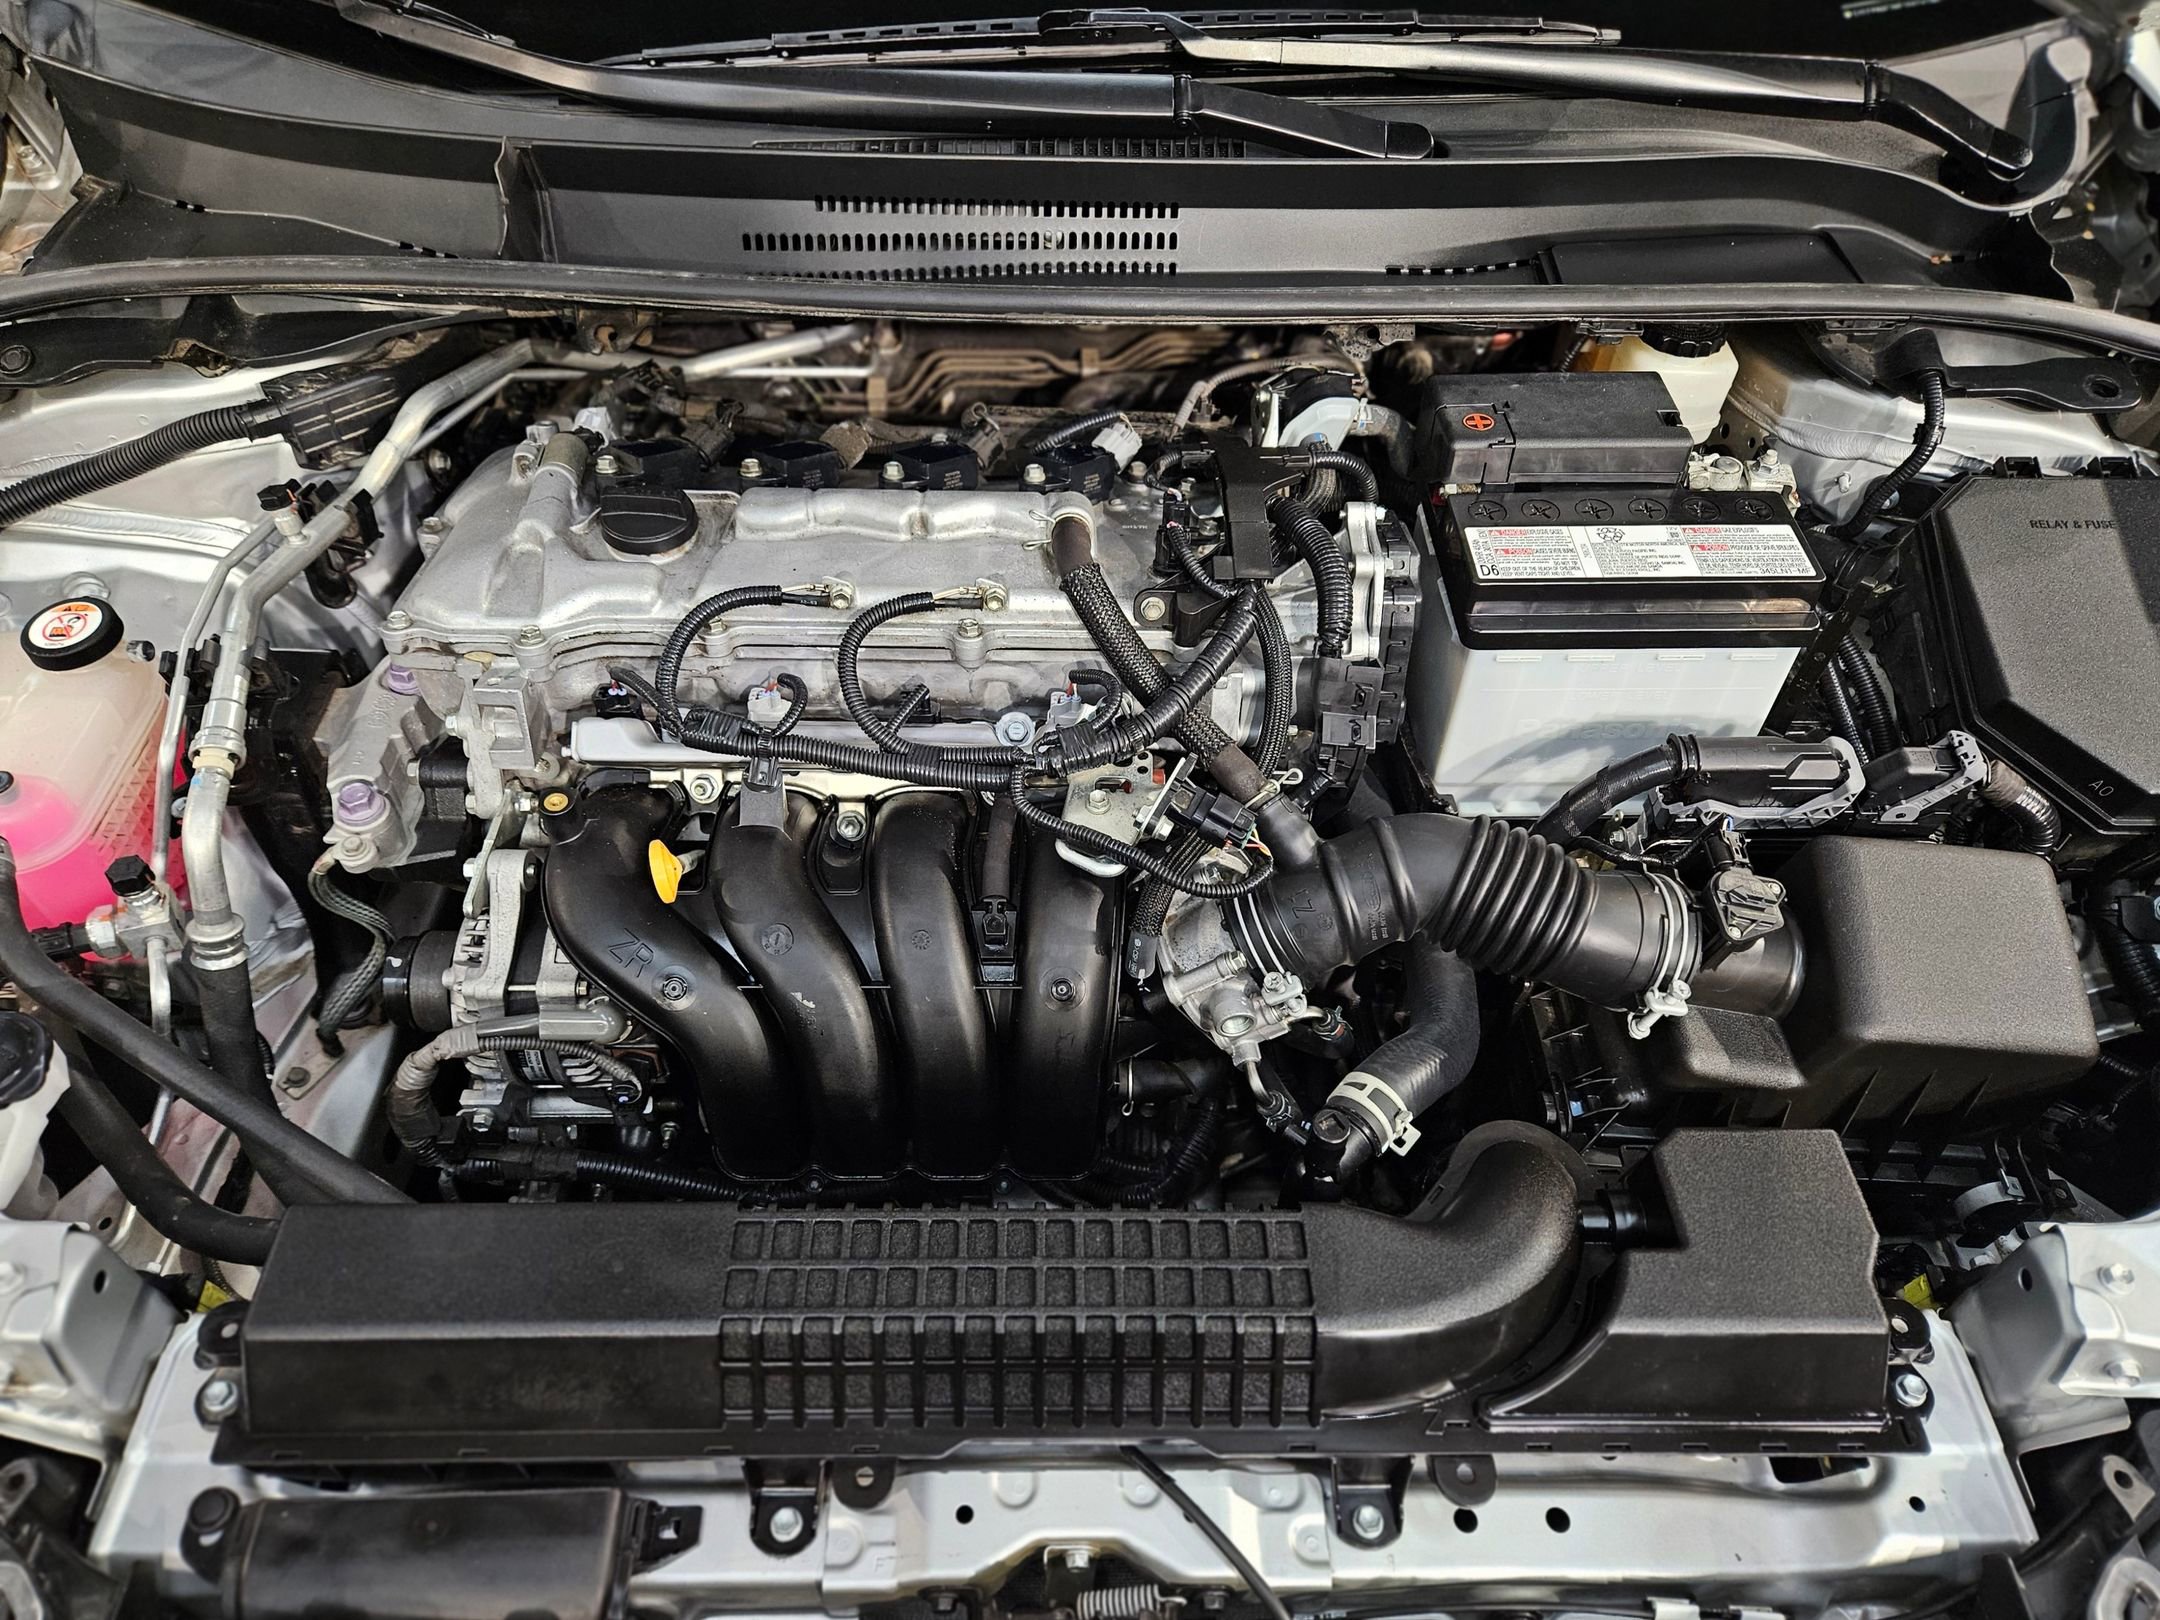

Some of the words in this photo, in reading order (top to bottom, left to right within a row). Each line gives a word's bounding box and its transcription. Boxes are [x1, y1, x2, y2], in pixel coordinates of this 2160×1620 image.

[2029, 519, 2069, 529] RELAY
[2073, 519, 2083, 529] &
[2084, 519, 2118, 529] FUSE
[1479, 564, 1500, 577] D6
[1637, 663, 1681, 673] LEVEL
[607, 926, 655, 979] ZR
